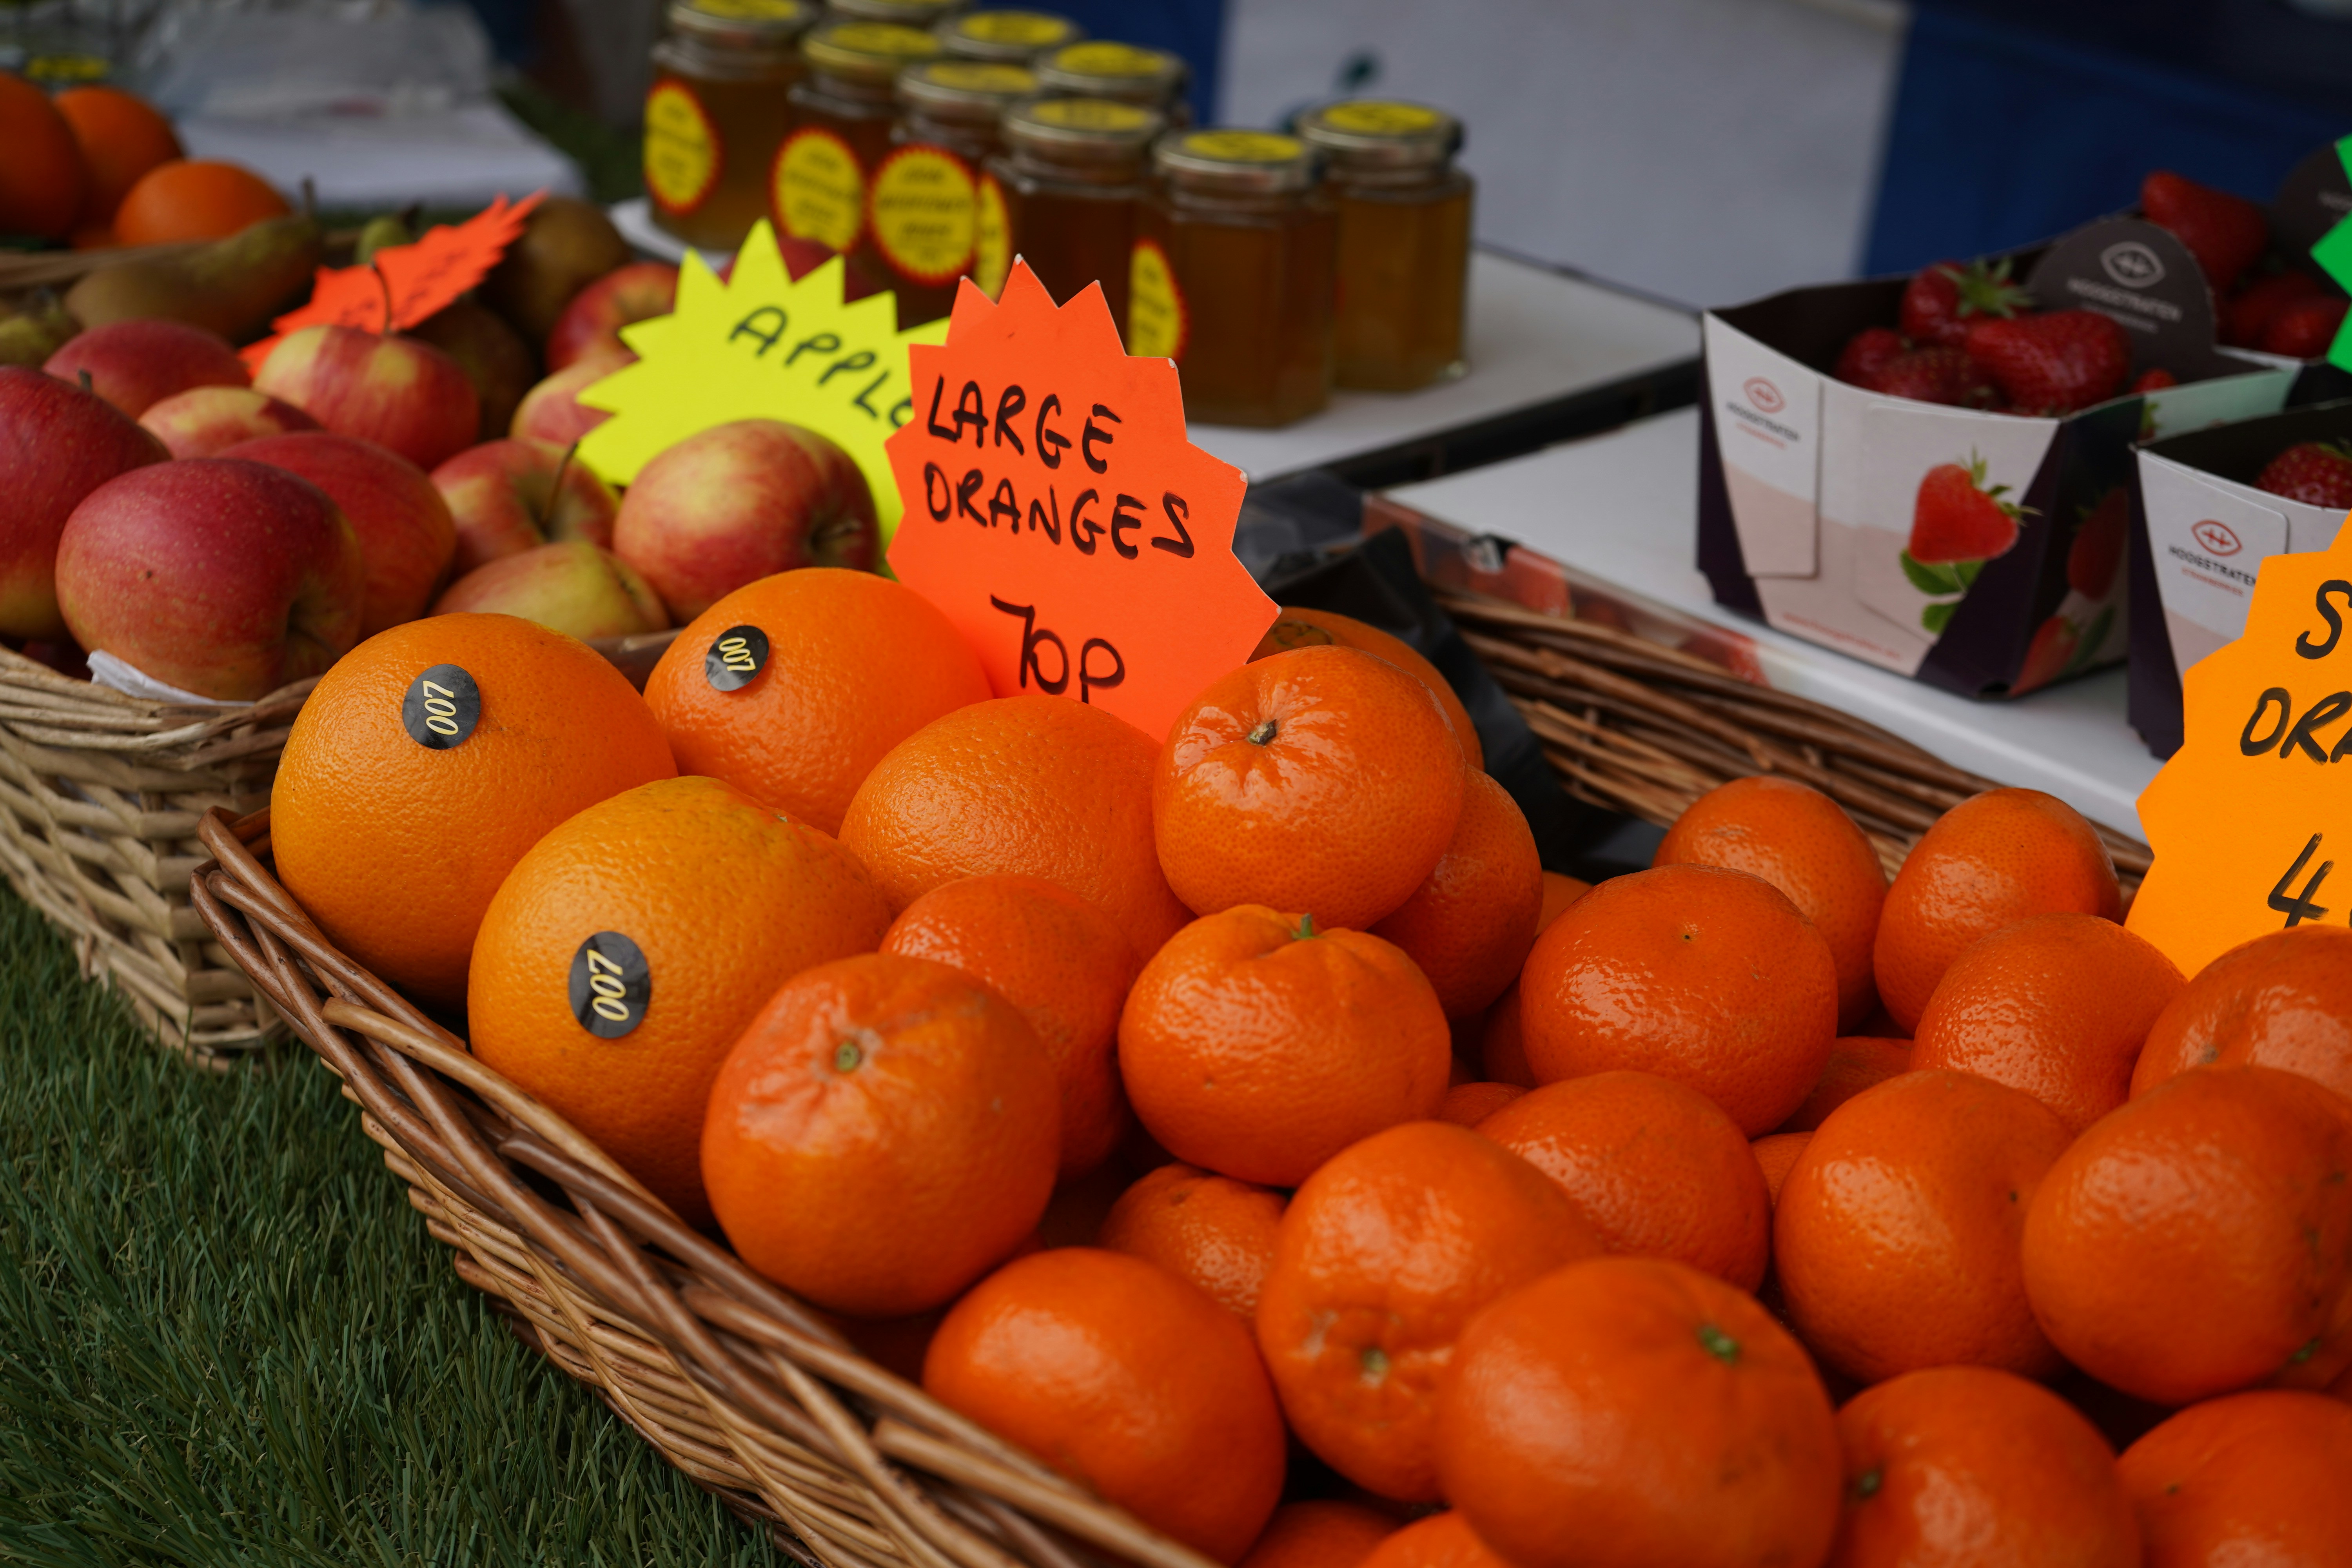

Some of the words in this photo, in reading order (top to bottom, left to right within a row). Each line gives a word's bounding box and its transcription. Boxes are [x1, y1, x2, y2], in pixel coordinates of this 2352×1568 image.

[927, 374, 1123, 474] LARGE
[923, 461, 1194, 560] ORANGES
[718, 637, 756, 671] 007
[423, 680, 459, 735] 007
[586, 949, 630, 1022] 007
